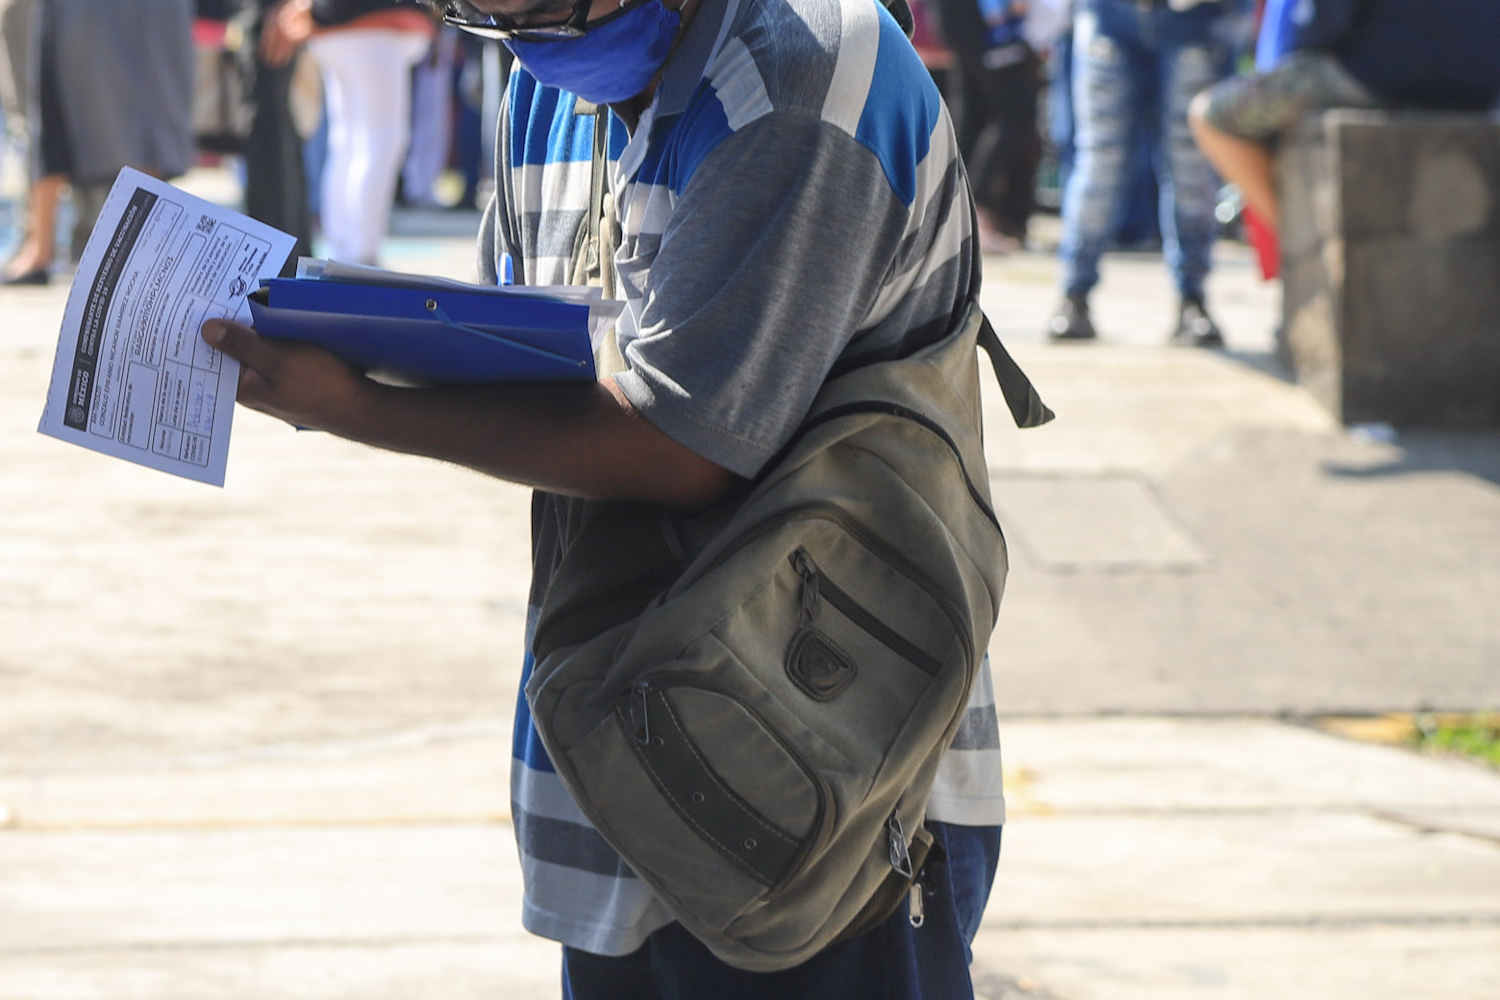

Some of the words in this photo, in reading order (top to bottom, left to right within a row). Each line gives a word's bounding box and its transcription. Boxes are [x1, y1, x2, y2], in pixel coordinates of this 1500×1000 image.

[80, 302, 97, 354] COMPROBANTE
[91, 291, 100, 303] DE
[108, 245, 118, 258] DE
[113, 203, 139, 248] VACUNACIÓN
[124, 269, 140, 297] ROCHA
[86, 327, 97, 356] CONTRA
[92, 317, 100, 328] LA
[76, 370, 90, 407] MÉXICO
